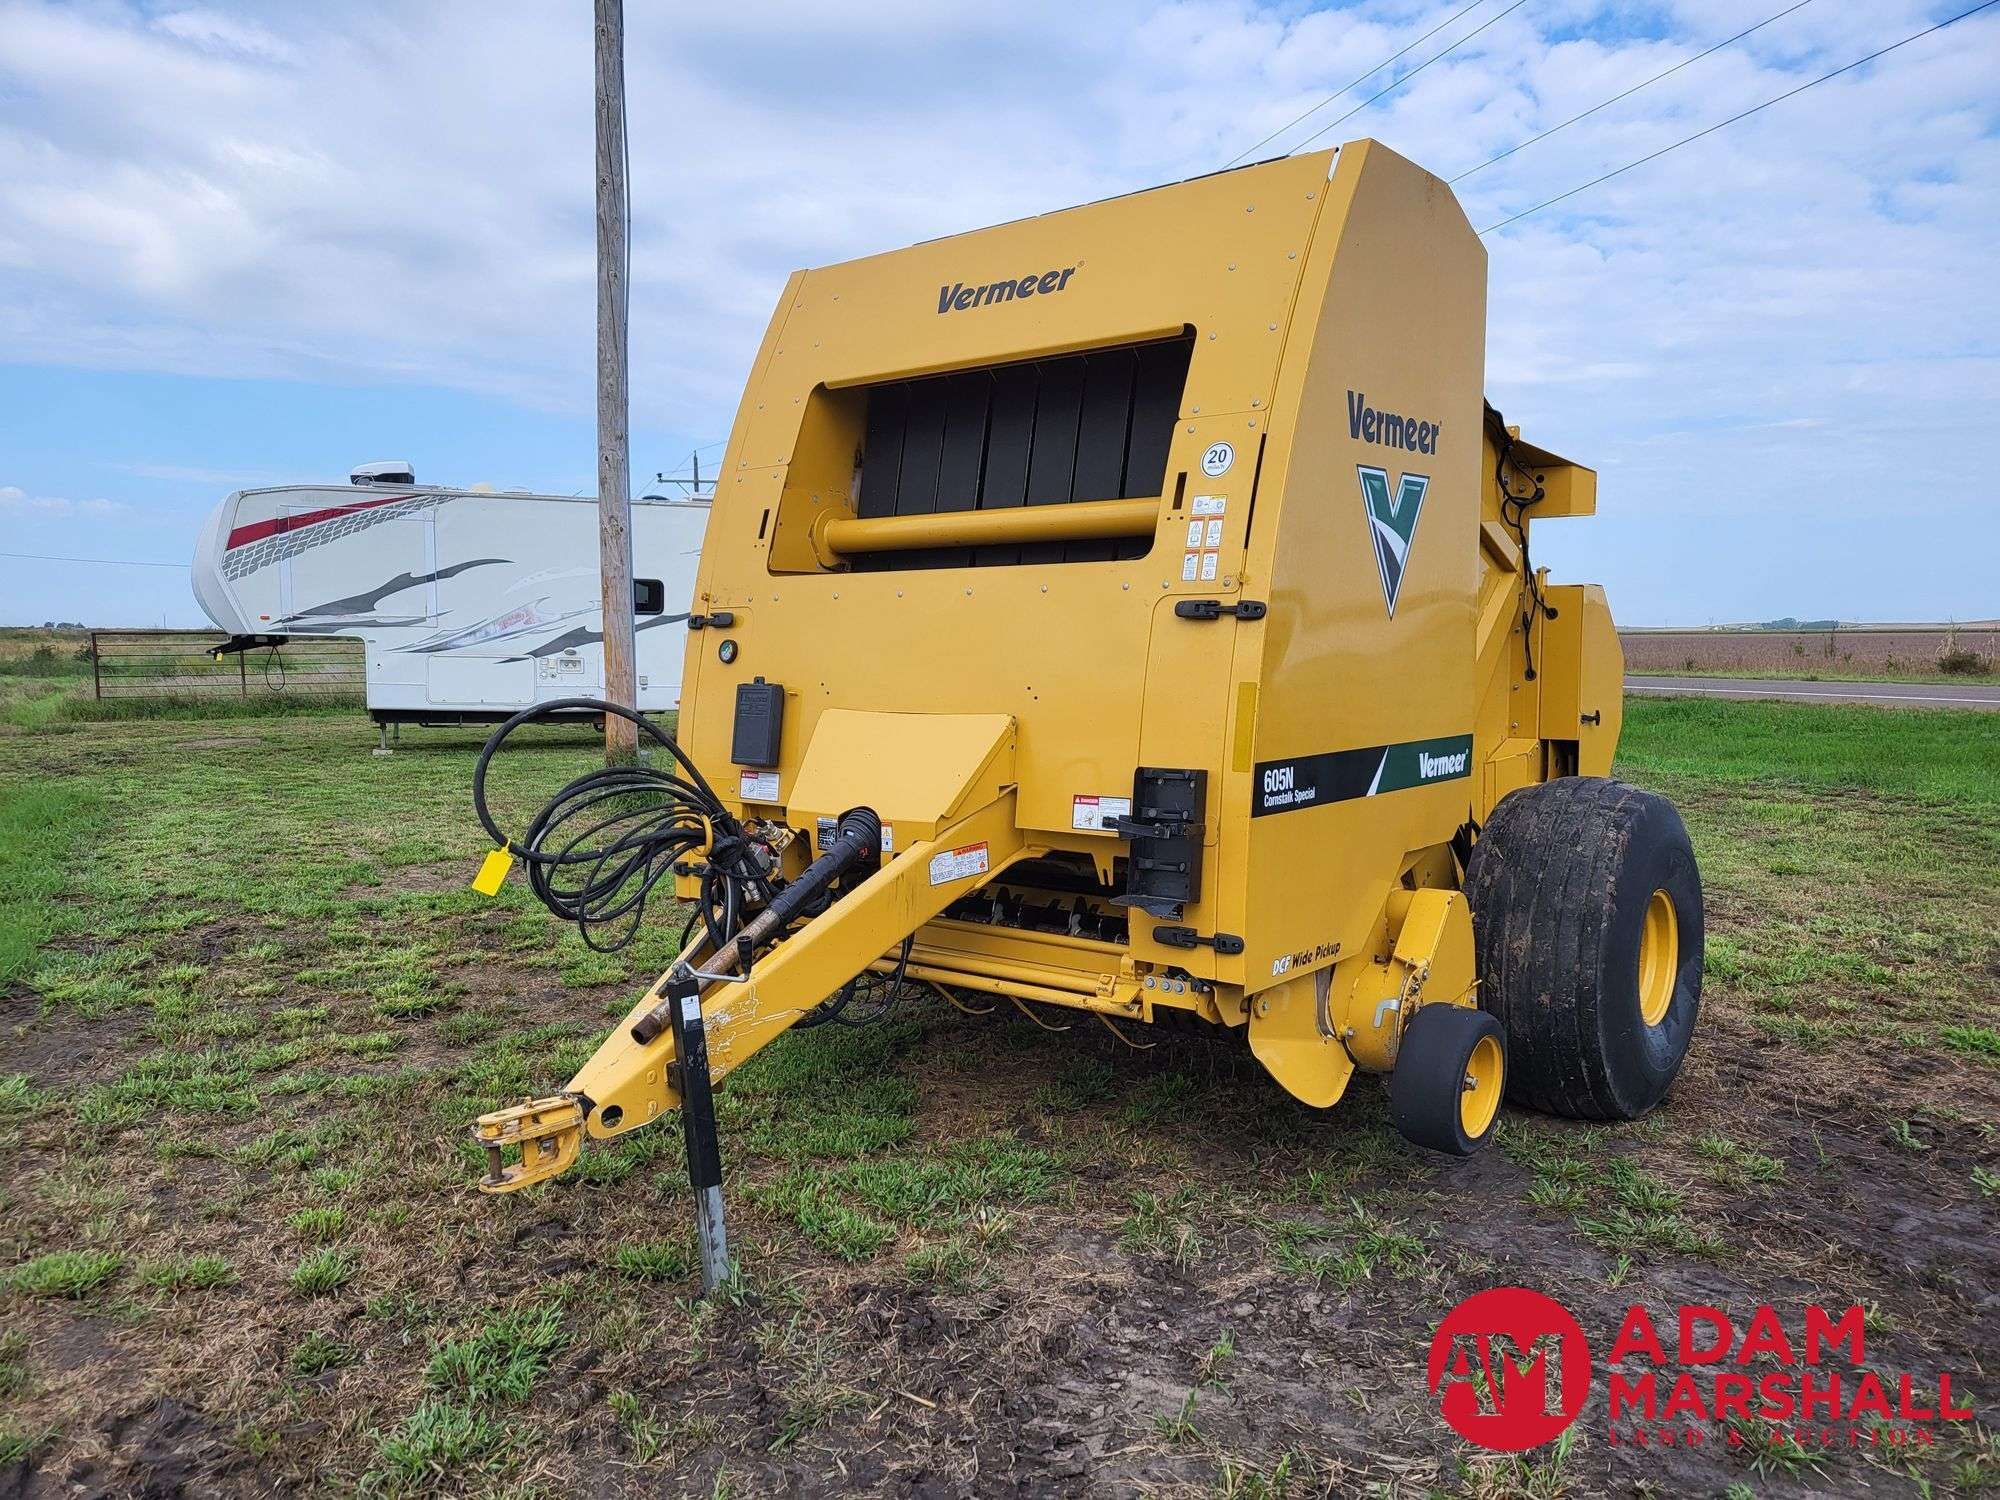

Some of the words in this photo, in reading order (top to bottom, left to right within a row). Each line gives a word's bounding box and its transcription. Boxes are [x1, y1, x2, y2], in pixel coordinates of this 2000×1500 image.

[937, 266, 1076, 314] Vermeer
[1347, 390, 1440, 455] Vermeer
[1208, 449, 1227, 464] 20
[1419, 751, 1467, 779] Vermeer
[1264, 766, 1294, 792] 605N
[1264, 790, 1294, 808] Cornstalk
[1294, 787, 1315, 804] Special
[1292, 950, 1313, 969] Wide
[1315, 942, 1341, 960] Pickup
